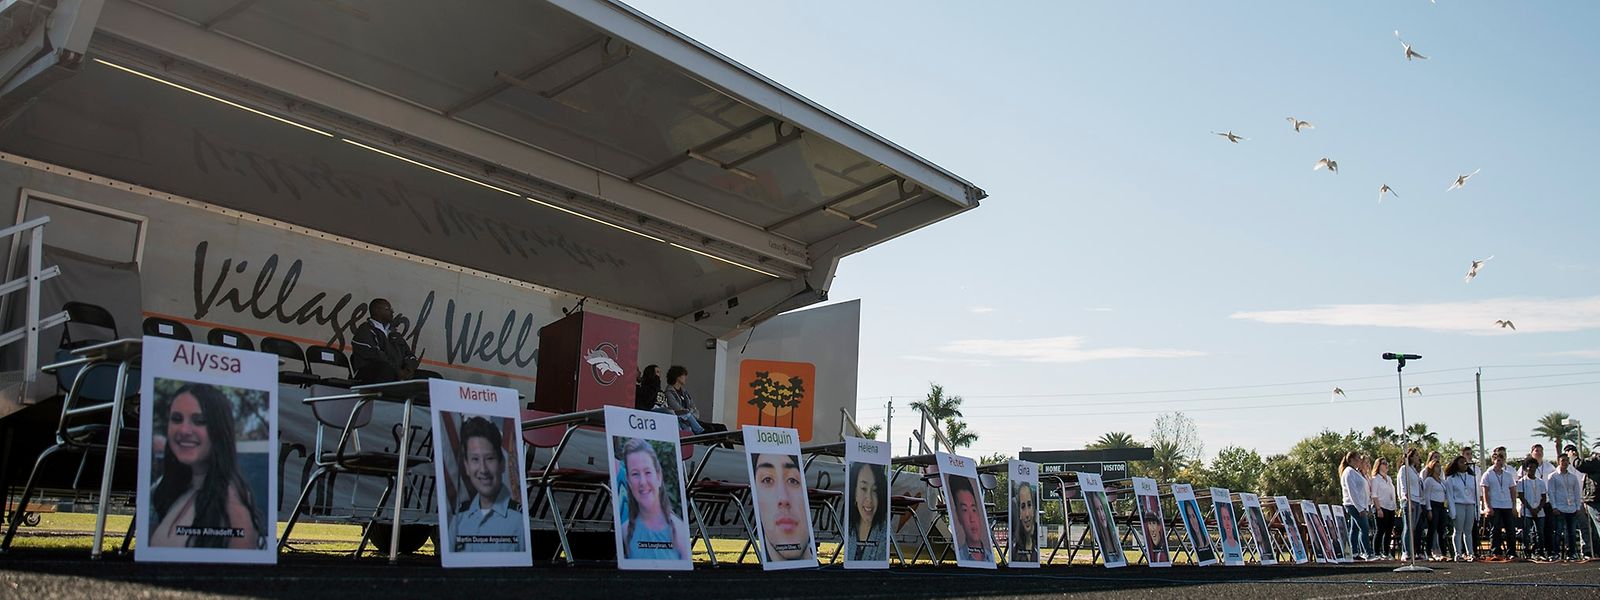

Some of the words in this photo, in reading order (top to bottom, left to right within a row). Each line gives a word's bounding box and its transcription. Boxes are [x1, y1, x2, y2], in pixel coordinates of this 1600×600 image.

[193, 240, 368, 352] Village
[173, 342, 242, 375] Alyssa
[459, 386, 498, 403] Martin
[628, 414, 657, 432] Cara
[756, 429, 792, 447] Joaquin
[857, 440, 879, 455] Helena
[1017, 464, 1030, 476] Gina
[1045, 465, 1062, 473] HOME
[1103, 463, 1125, 472] VISITOR
[176, 527, 201, 537] Alyssa
